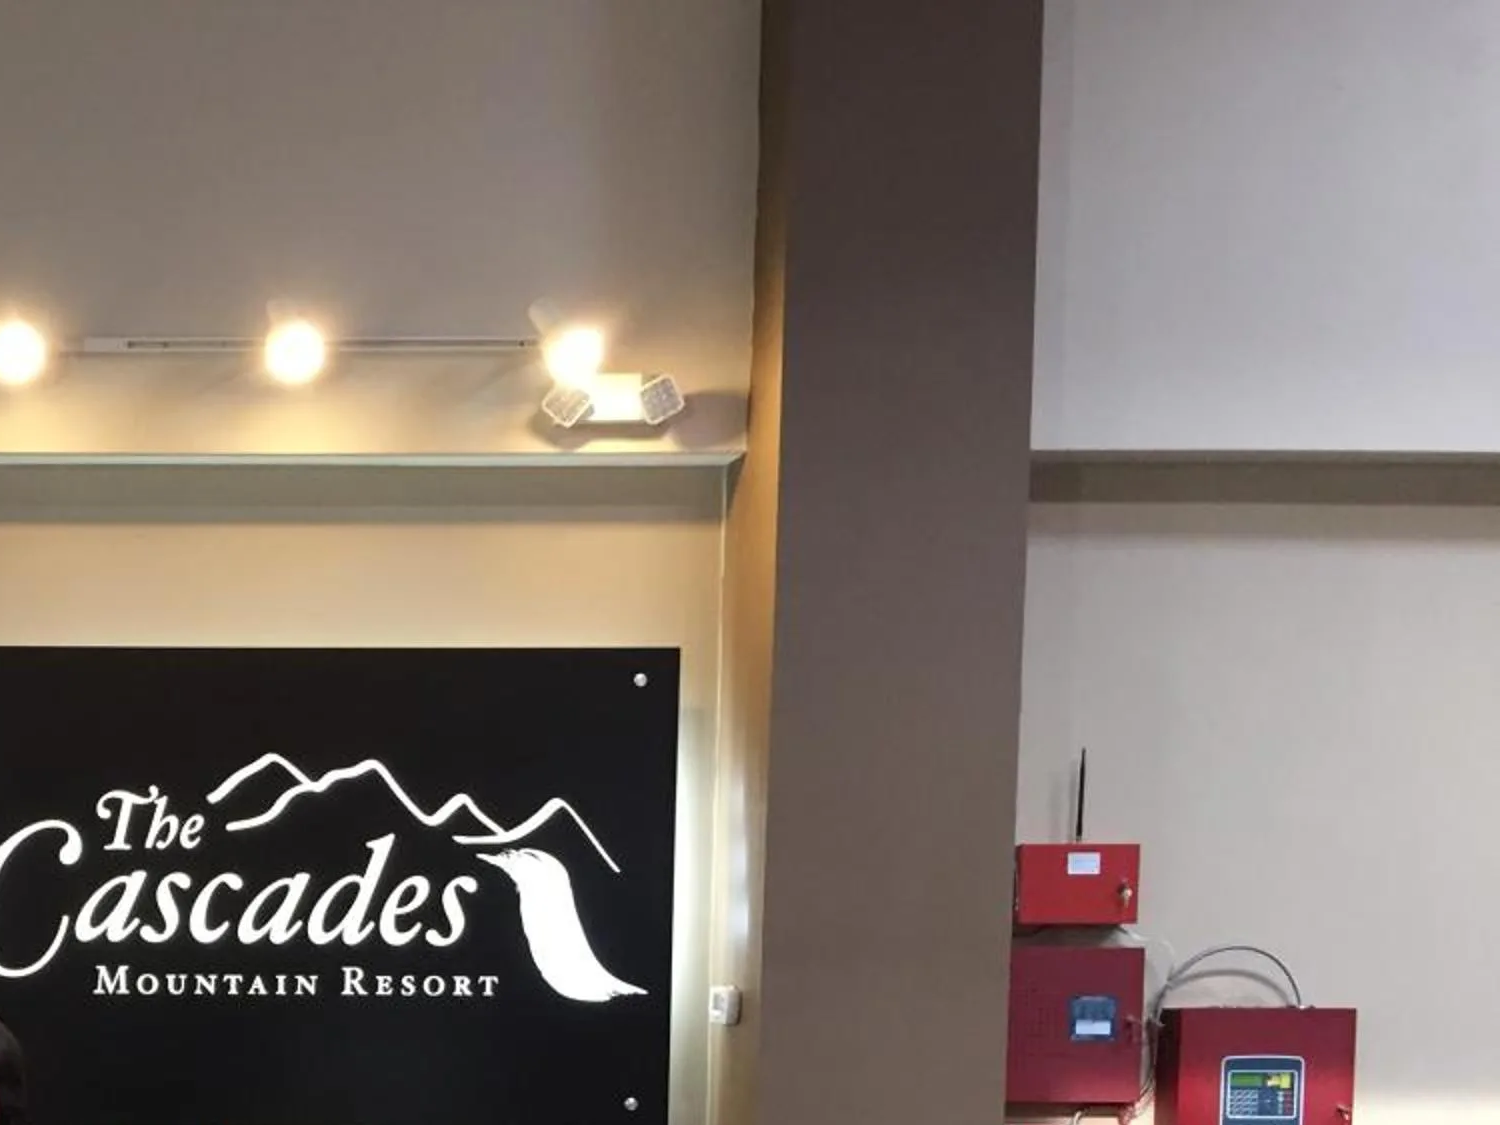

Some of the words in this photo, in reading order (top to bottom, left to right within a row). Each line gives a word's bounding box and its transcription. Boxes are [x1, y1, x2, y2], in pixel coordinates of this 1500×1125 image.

[95, 784, 206, 851] The
[93, 965, 319, 996] MOUNTAIN
[341, 966, 499, 997] RESORT
